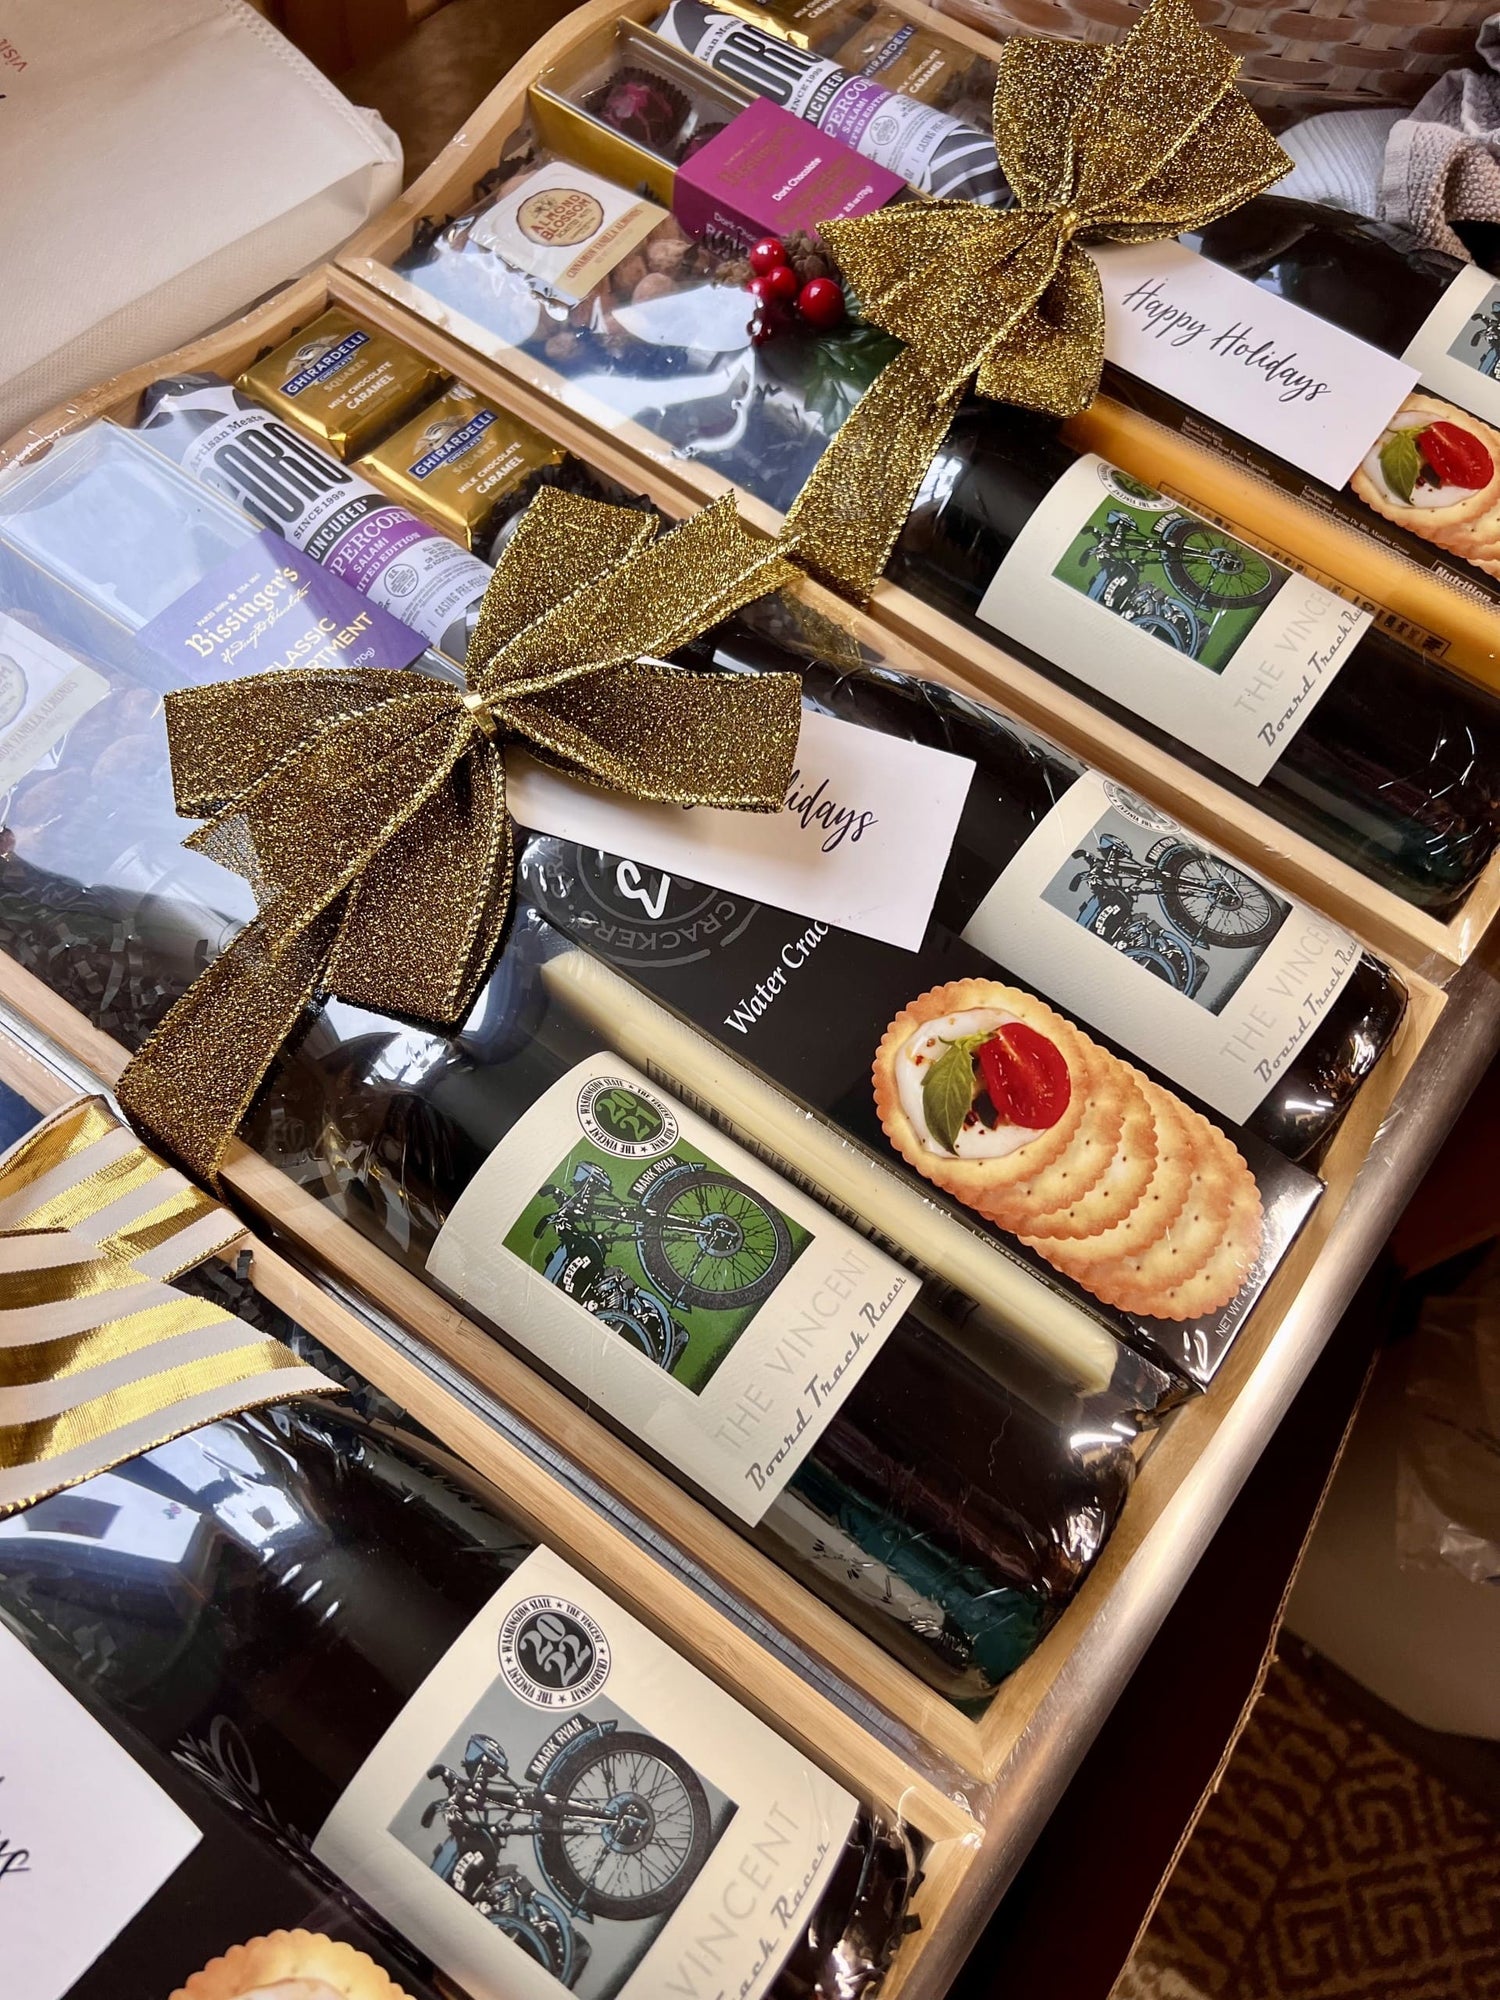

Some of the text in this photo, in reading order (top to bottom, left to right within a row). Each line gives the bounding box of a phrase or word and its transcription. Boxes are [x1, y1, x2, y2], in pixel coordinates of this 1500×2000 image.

[863, 25, 915, 77] HIRARDELLI
[909, 60, 946, 94] CARAMEL
[842, 98, 868, 133] SALAMI
[771, 157, 823, 203] Dark Chocolate
[530, 194, 582, 234] ALMOND
[540, 198, 593, 241] BLOSSOM
[286, 332, 366, 395] GHIRARDELLI
[1121, 277, 1332, 402] Happy Holidays
[327, 393, 349, 410] MILK
[348, 360, 394, 395] CHOCOLATE
[346, 374, 396, 411] CARAMEL
[228, 414, 266, 434] Meats
[414, 411, 495, 476] GHIRARDELLI
[451, 439, 498, 476] SQUARES
[457, 476, 479, 495] MILK
[477, 441, 522, 479] CHOCOLATE
[475, 456, 526, 495] CARAMEL
[292, 490, 347, 541] SINCE 1999
[352, 536, 390, 575] SALAMI
[380, 530, 422, 566] EDITION
[184, 566, 300, 658] Bissinger's
[1232, 659, 1286, 714] THE
[1256, 674, 1317, 748] Board
[1306, 622, 1354, 675] Track
[578, 899, 738, 951] CRACKERS
[722, 965, 788, 1035] Water
[1253, 1015, 1312, 1084] Board
[1302, 965, 1346, 1017] Track
[1219, 1004, 1278, 1064] THE
[588, 1127, 637, 1155] THE VINCENT
[632, 1155, 679, 1196] MARK RYAN
[714, 1248, 872, 1450] THE VINCENT
[1215, 1313, 1233, 1338] NET
[744, 1276, 908, 1493] Board Track Racer
[501, 1598, 553, 1654] WASHINGTON STATE
[565, 1604, 606, 1645] THE VINCENT
[506, 1666, 554, 1705] THE VINCENT
[569, 1657, 609, 1703] CHARDONNAY
[530, 1717, 584, 1777] MARK RYAN
[663, 1800, 801, 2000] VINCENT
[770, 1841, 831, 1931] Racer
